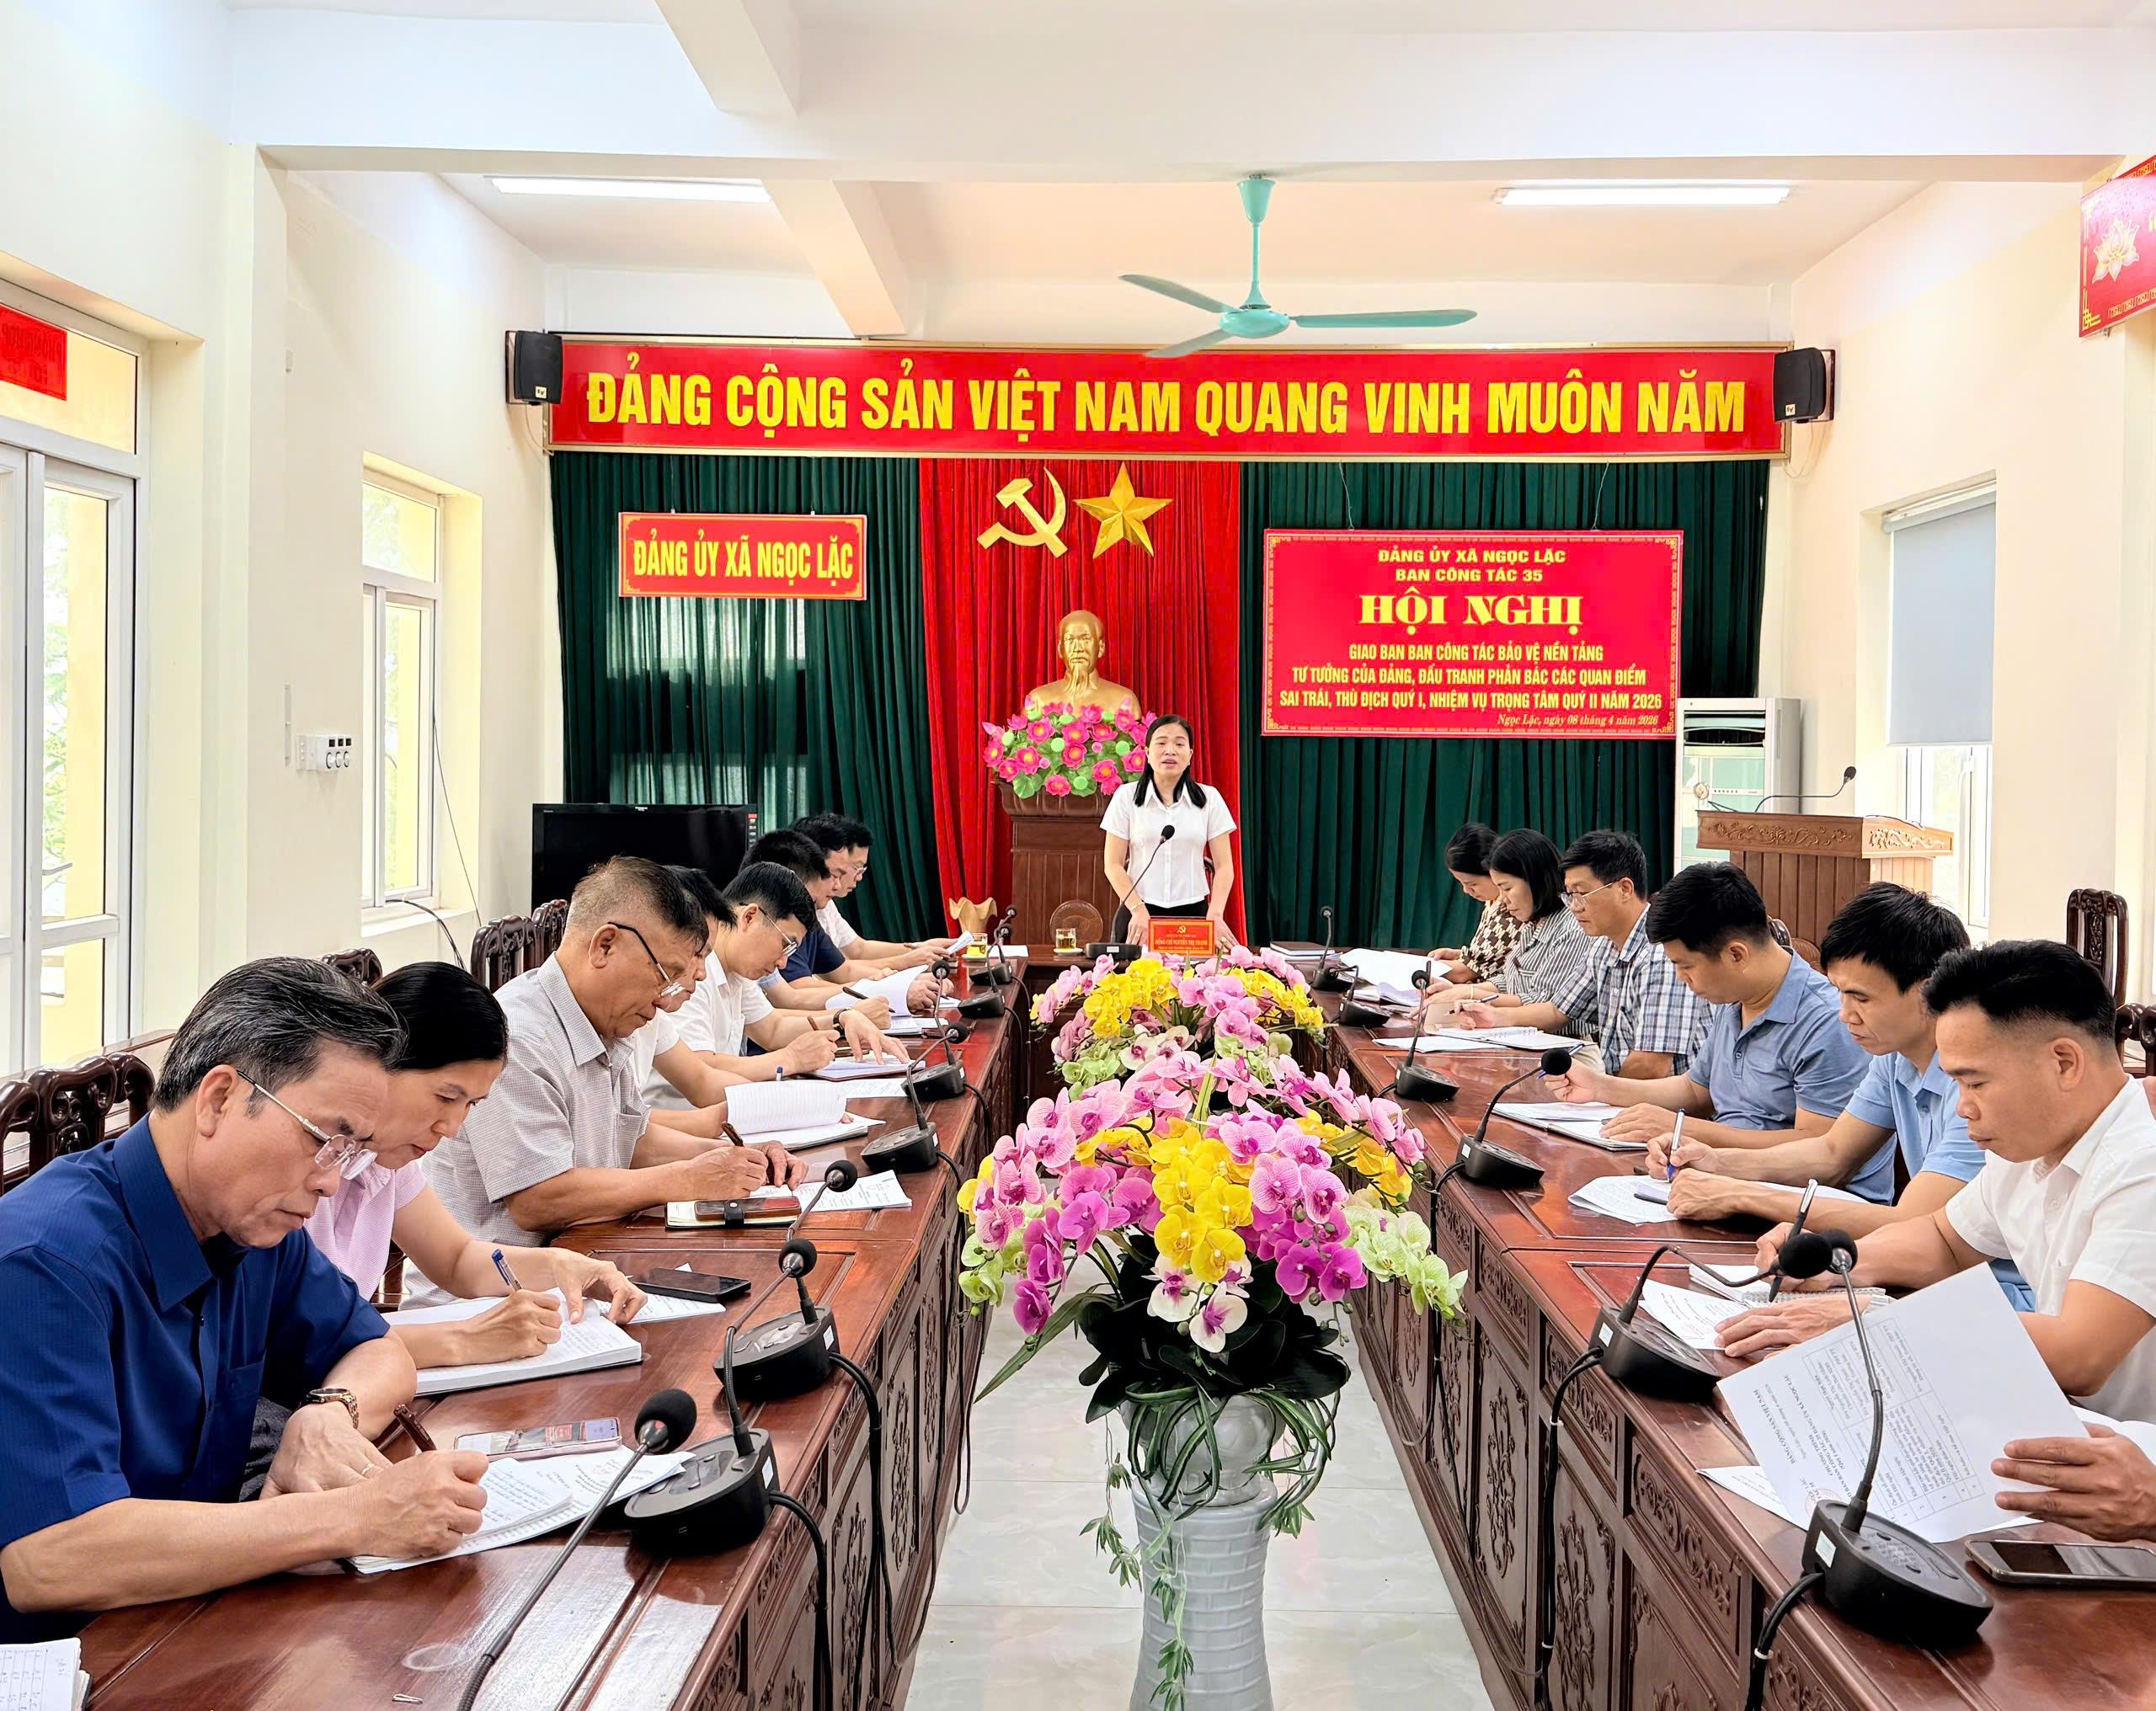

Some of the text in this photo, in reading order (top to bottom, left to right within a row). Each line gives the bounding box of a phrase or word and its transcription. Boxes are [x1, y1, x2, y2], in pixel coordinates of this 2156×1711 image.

[587, 352, 1744, 441] ĐẢNG CỘNG SẢN VIỆT NAM QUANG VINH MUÔN NĂM
[633, 528, 852, 586] ĐẢNG ỦY XÃ NGỌC LẶC
[1379, 546, 1565, 565] ĐẢNG ỦY XÃ NGỌC LẶC
[1396, 567, 1543, 581] BAN CÔNG TÁC 35
[1359, 586, 1583, 635] HỘI NGHỊ
[1349, 644, 1376, 659] GIAO
[1380, 645, 1405, 660] BAN
[1408, 645, 1433, 660] BAN
[1437, 642, 1469, 660] CÔNG
[1472, 642, 1494, 660] TÁC
[1498, 641, 1522, 660] BẢO
[1526, 642, 1540, 664] VỆ
[1572, 641, 1603, 661] TẢNG
[1292, 663, 1646, 686] TƯ TƯỞNG CỦA ĐẢNG, ĐẤU TRANH PHẢN BÁC CÁC QUAN ĐIỂM
[1280, 690, 1299, 706] SAI
[1302, 689, 1331, 707] TRÁI,
[1361, 691, 1388, 710] ĐỊCH
[1392, 689, 1415, 708] QUÝ
[1430, 690, 1468, 711] NHIỆM
[1472, 693, 1487, 712] VỤ
[1491, 693, 1529, 712] TRỌNG
[1533, 690, 1559, 708] TÂM
[1563, 690, 1586, 710] QUÝ
[1590, 694, 1597, 708] II
[1601, 690, 1629, 708] NĂM
[1633, 694, 1662, 709] 2026
